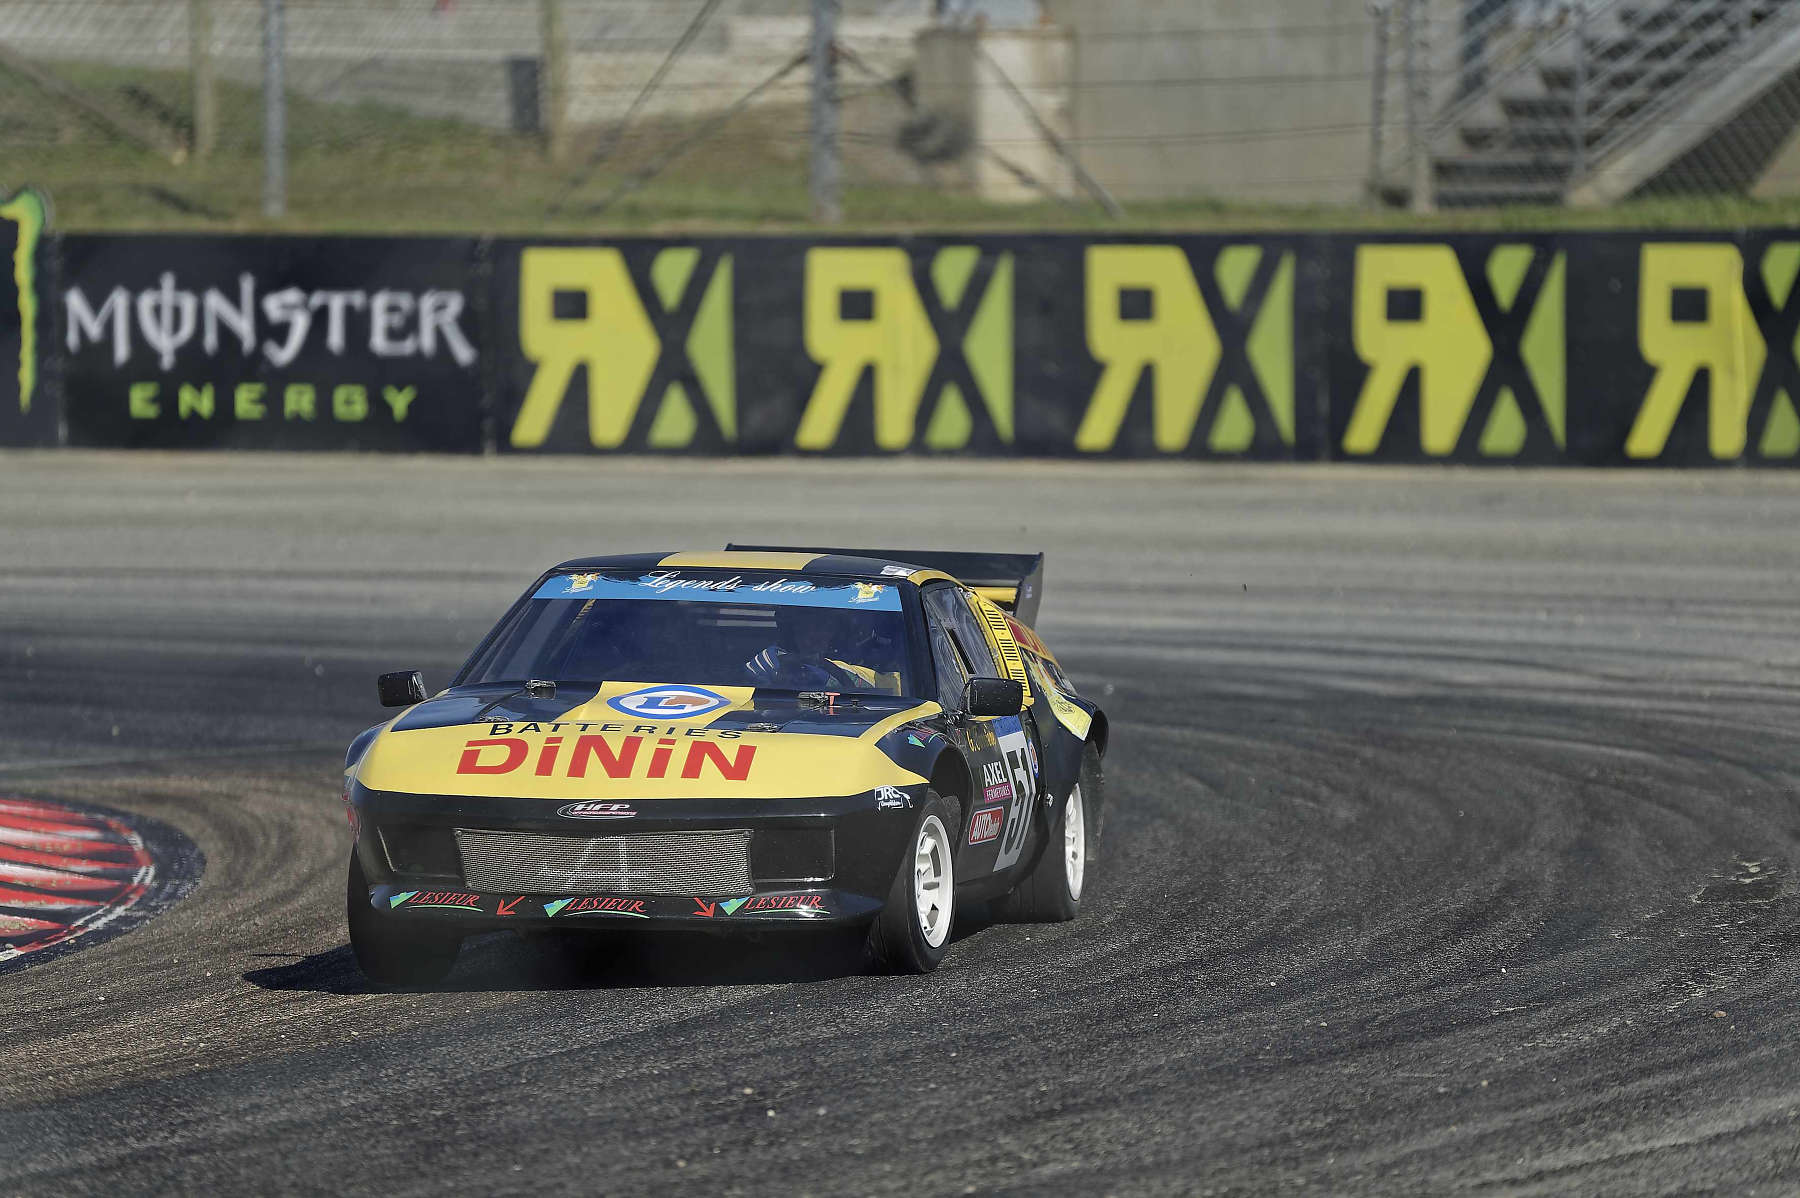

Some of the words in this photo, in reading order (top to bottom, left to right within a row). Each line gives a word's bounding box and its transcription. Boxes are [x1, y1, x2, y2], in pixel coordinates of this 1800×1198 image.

[65, 272, 477, 370] MONSTER
[129, 382, 416, 421] ENERGY
[649, 570, 744, 593] Legends
[752, 578, 817, 593] show
[489, 721, 743, 740] BATTERIES
[983, 760, 1008, 788] AXEL
[408, 891, 480, 907] LESIEUR
[566, 897, 648, 912] LESIEUR
[744, 895, 825, 910] LESIEUR
